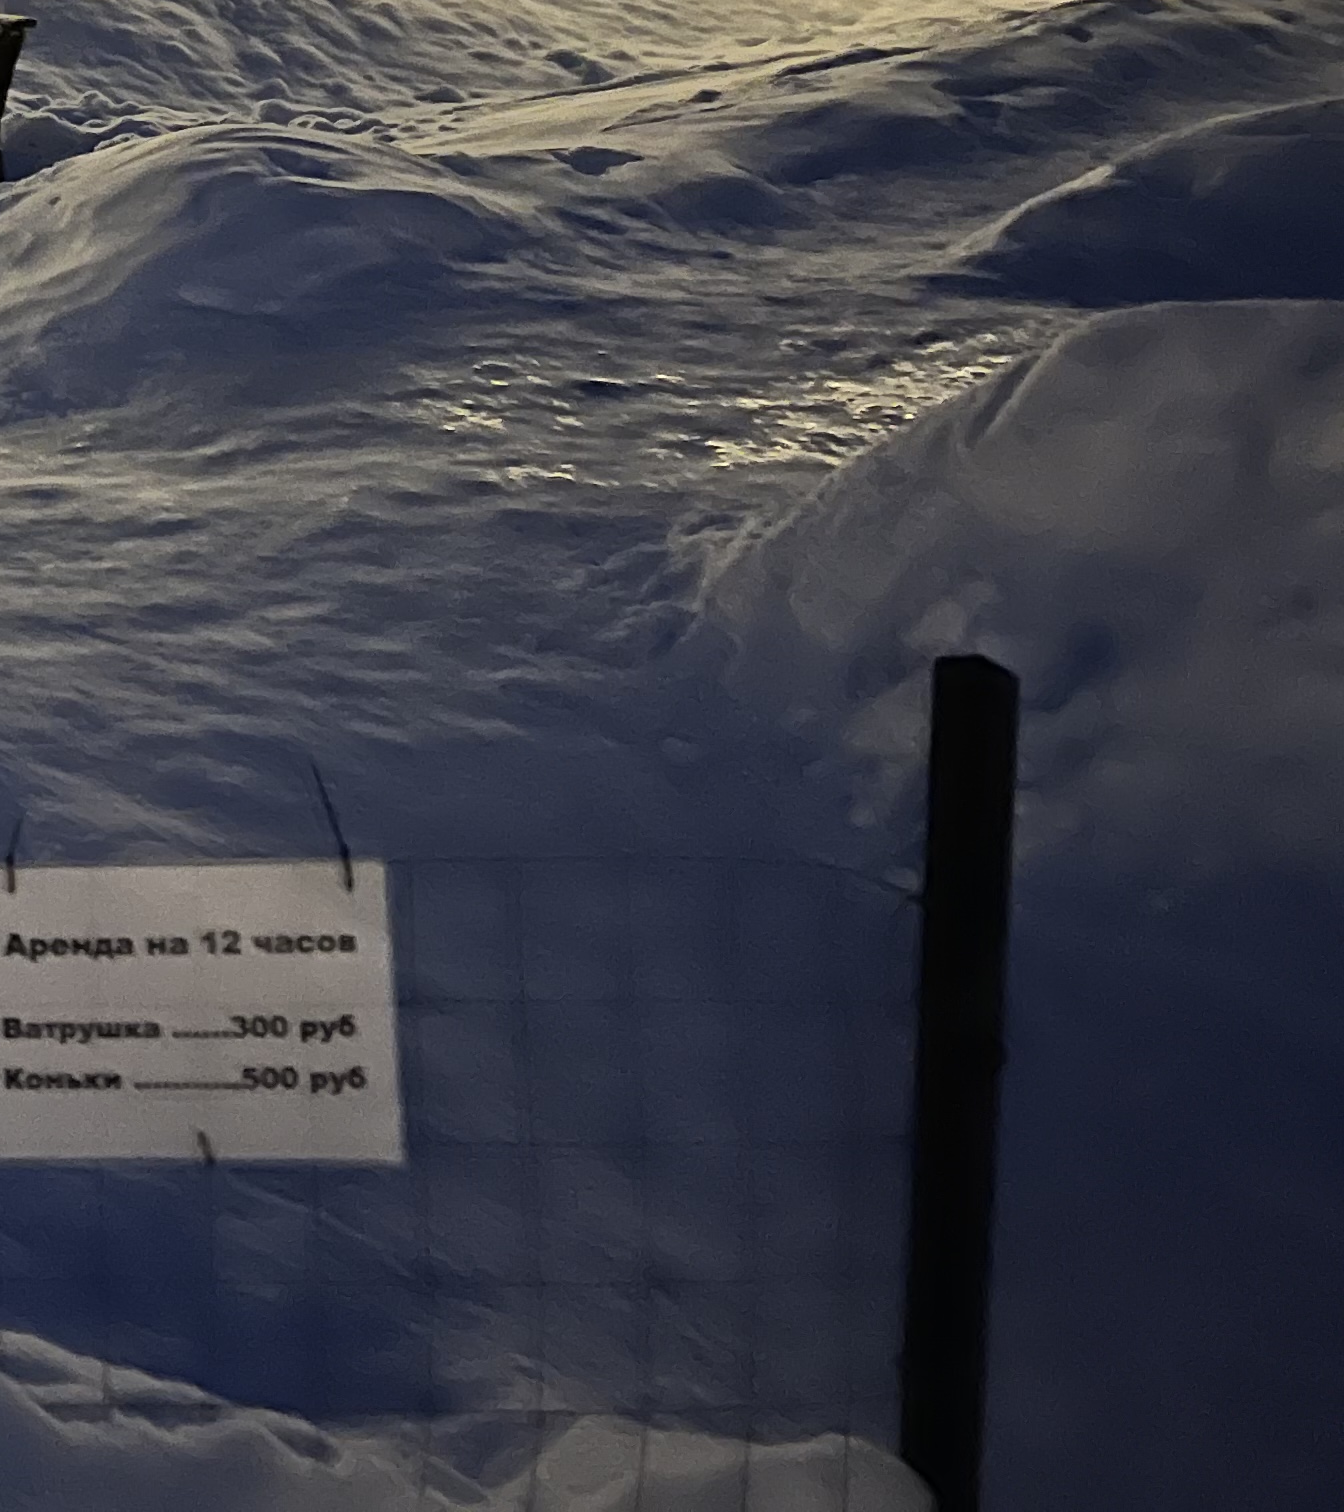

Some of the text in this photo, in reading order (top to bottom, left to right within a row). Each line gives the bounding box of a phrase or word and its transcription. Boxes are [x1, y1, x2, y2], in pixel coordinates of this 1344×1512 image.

[3, 930, 358, 961] Аренда на 12 часов
[2, 1018, 160, 1042] Ватрушка
[300, 1014, 356, 1042] руб
[3, 1068, 123, 1090] Коньки
[310, 1066, 367, 1094] руб
